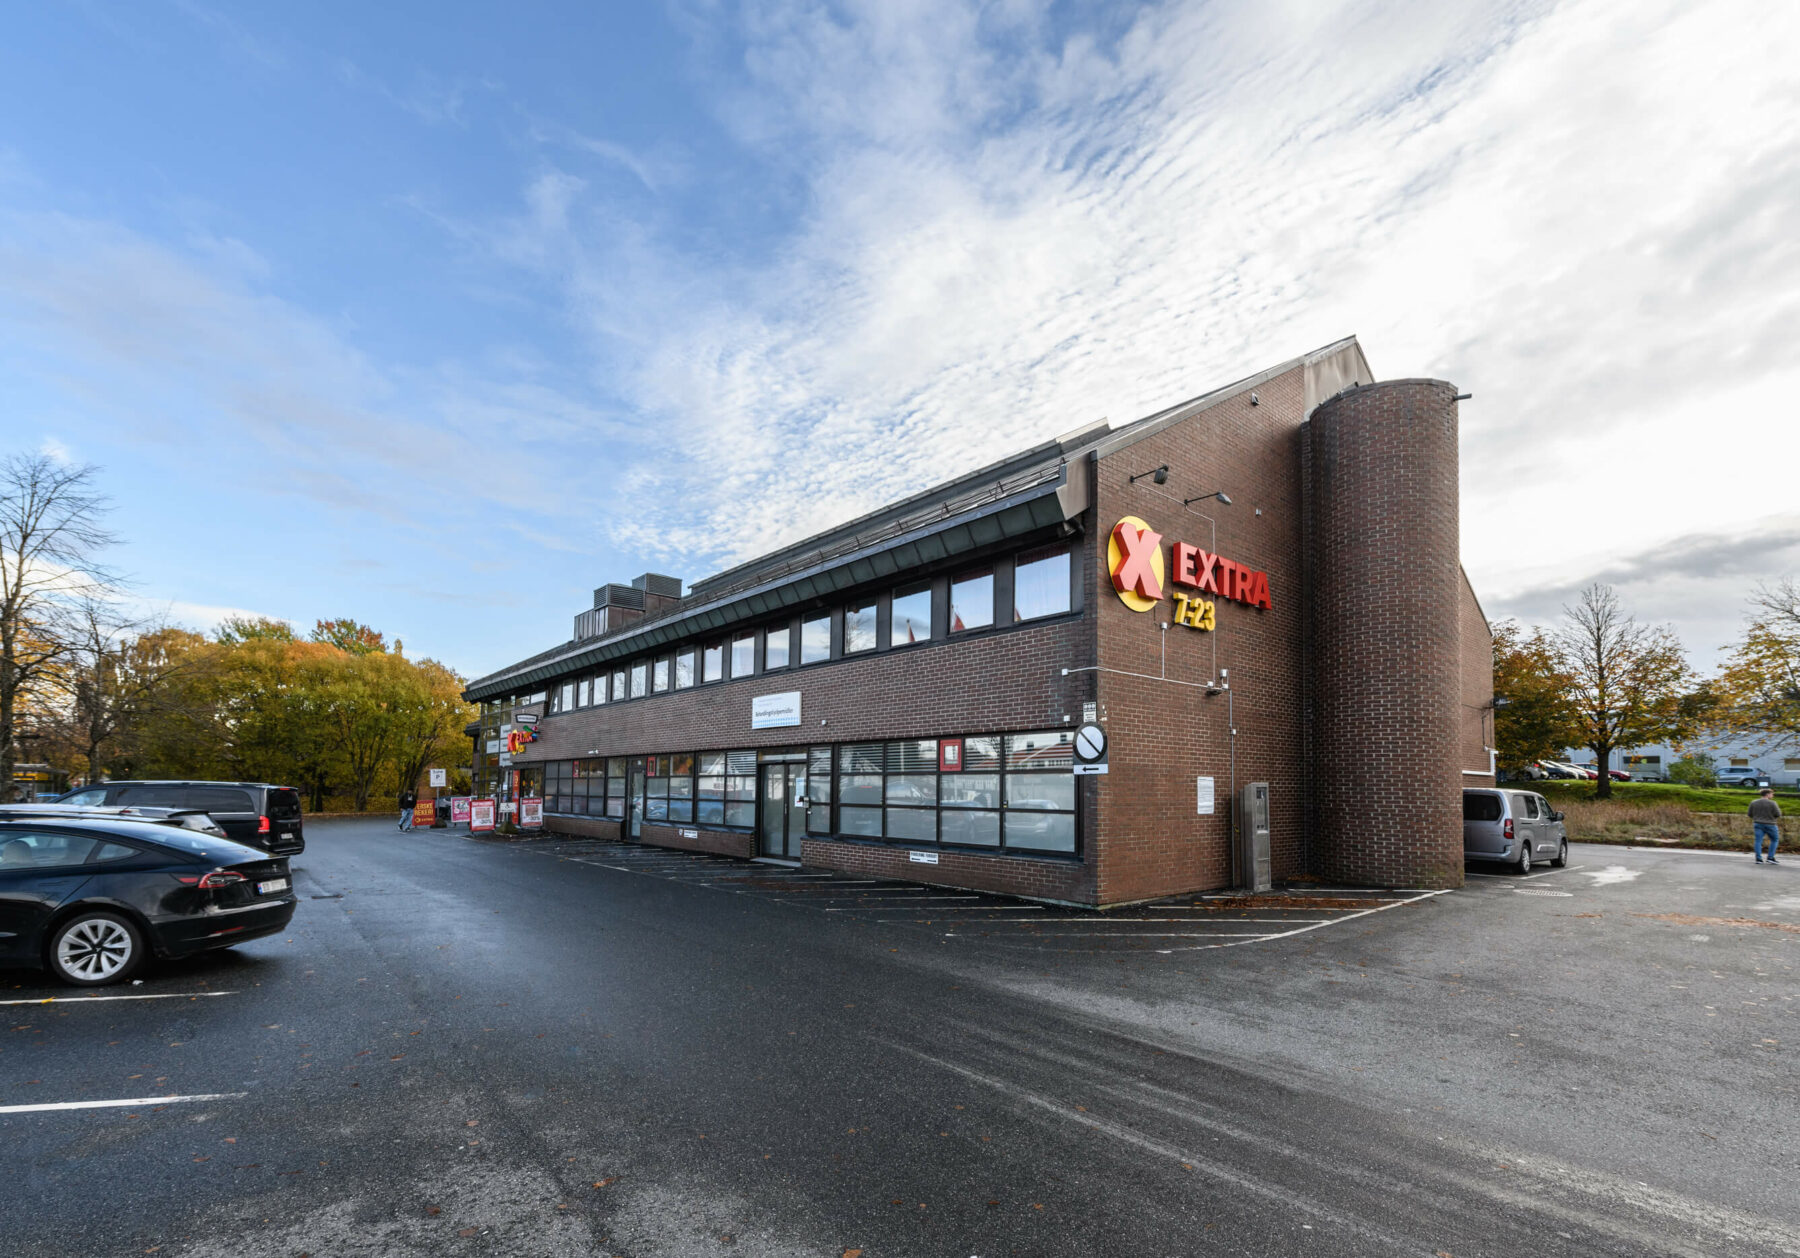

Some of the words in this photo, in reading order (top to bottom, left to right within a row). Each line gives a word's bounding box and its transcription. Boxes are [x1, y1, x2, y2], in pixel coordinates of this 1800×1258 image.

[1112, 522, 1164, 600] X
[1173, 541, 1272, 610] EXTRA
[1173, 592, 1216, 631] 7-23
